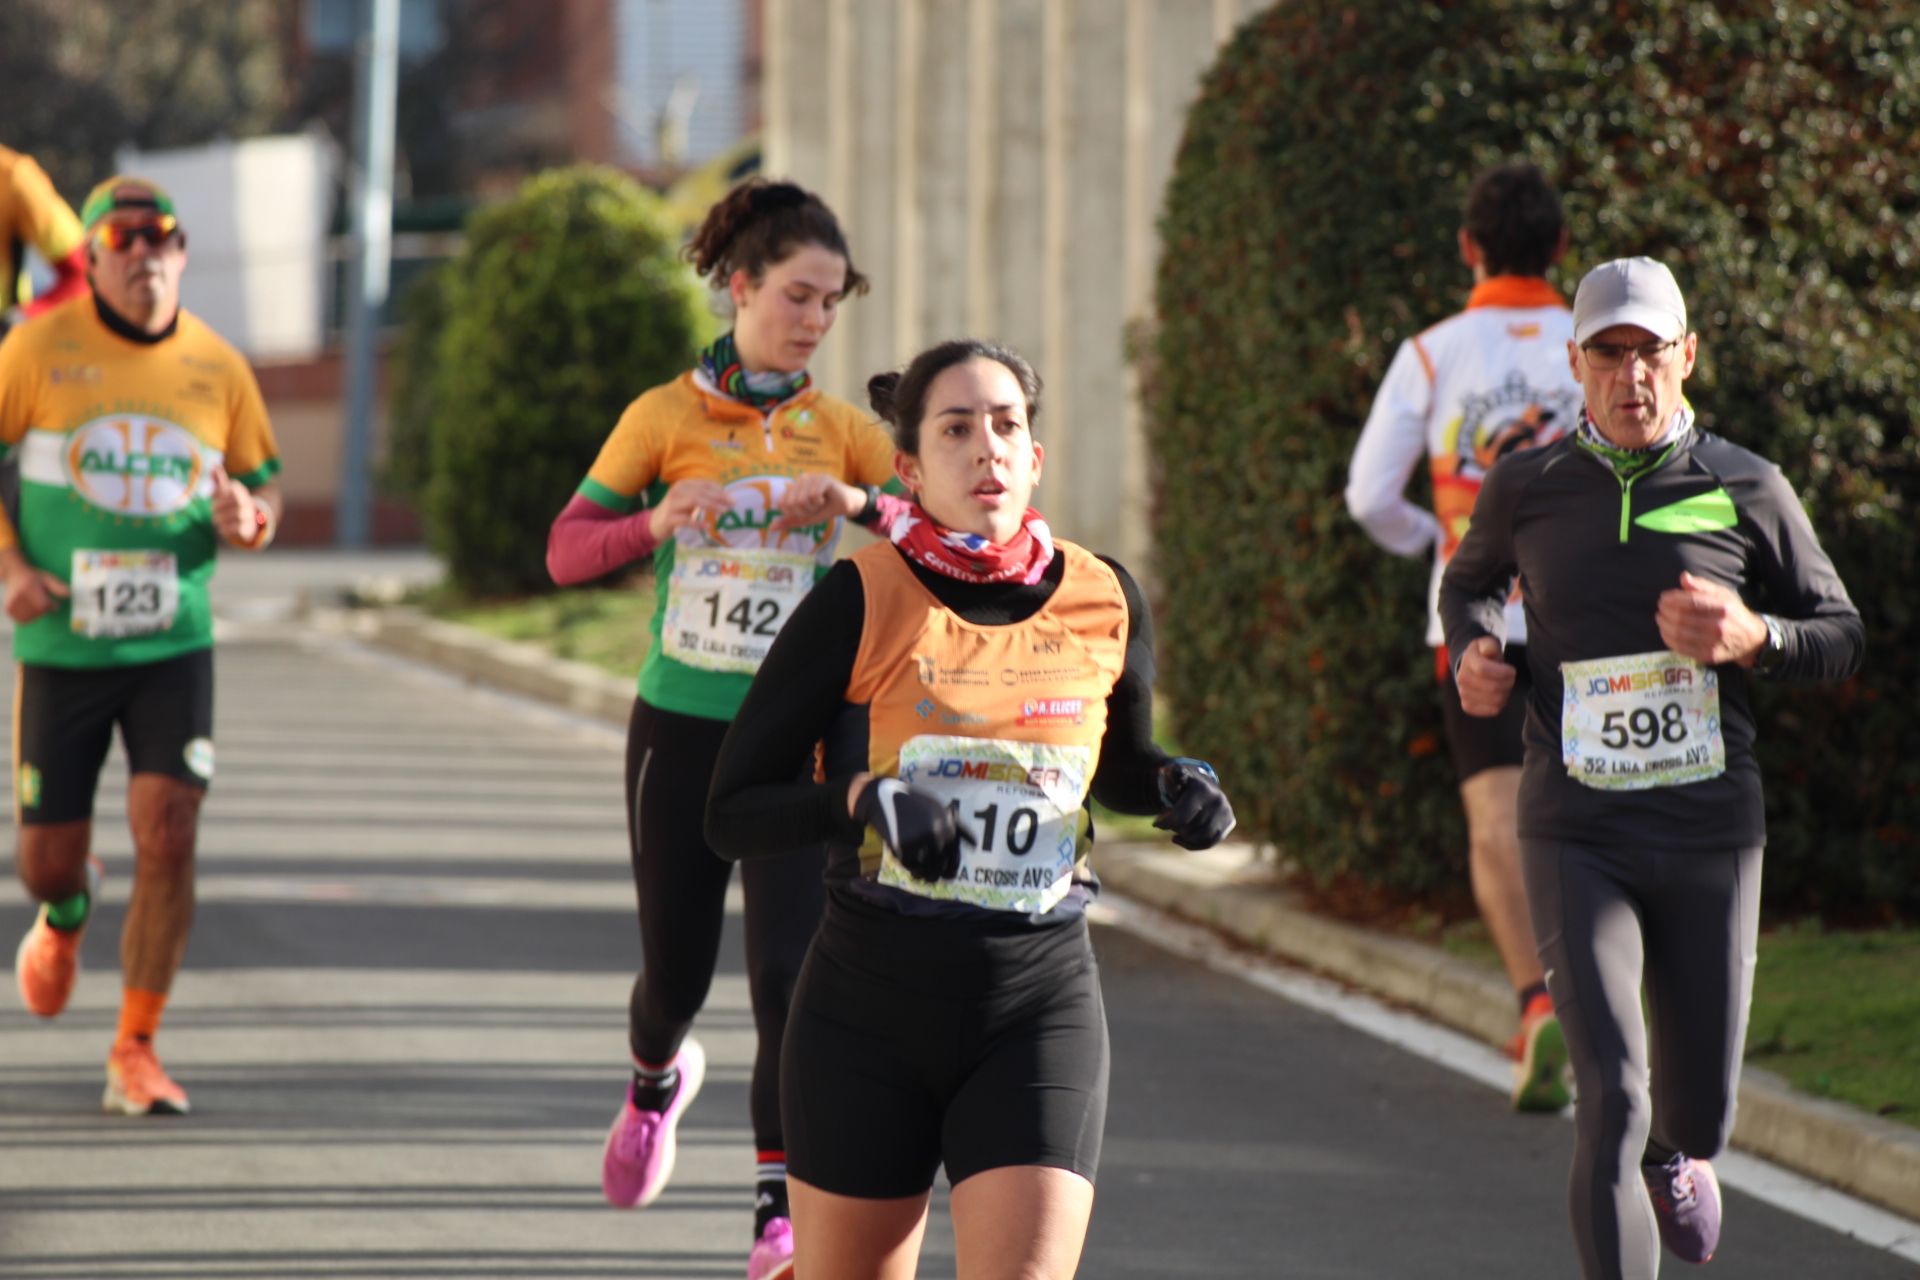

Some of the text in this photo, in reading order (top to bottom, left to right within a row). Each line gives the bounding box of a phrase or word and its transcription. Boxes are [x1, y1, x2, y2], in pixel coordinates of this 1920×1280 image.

[696, 560, 794, 583] JOMISAGA
[92, 583, 161, 614] 123
[705, 591, 781, 636] 142
[678, 630, 699, 650] 32
[1586, 667, 1693, 697] JOMISAGA
[1601, 702, 1688, 749] 598
[1584, 757, 1606, 775] 32
[974, 868, 1020, 886] CROSS
